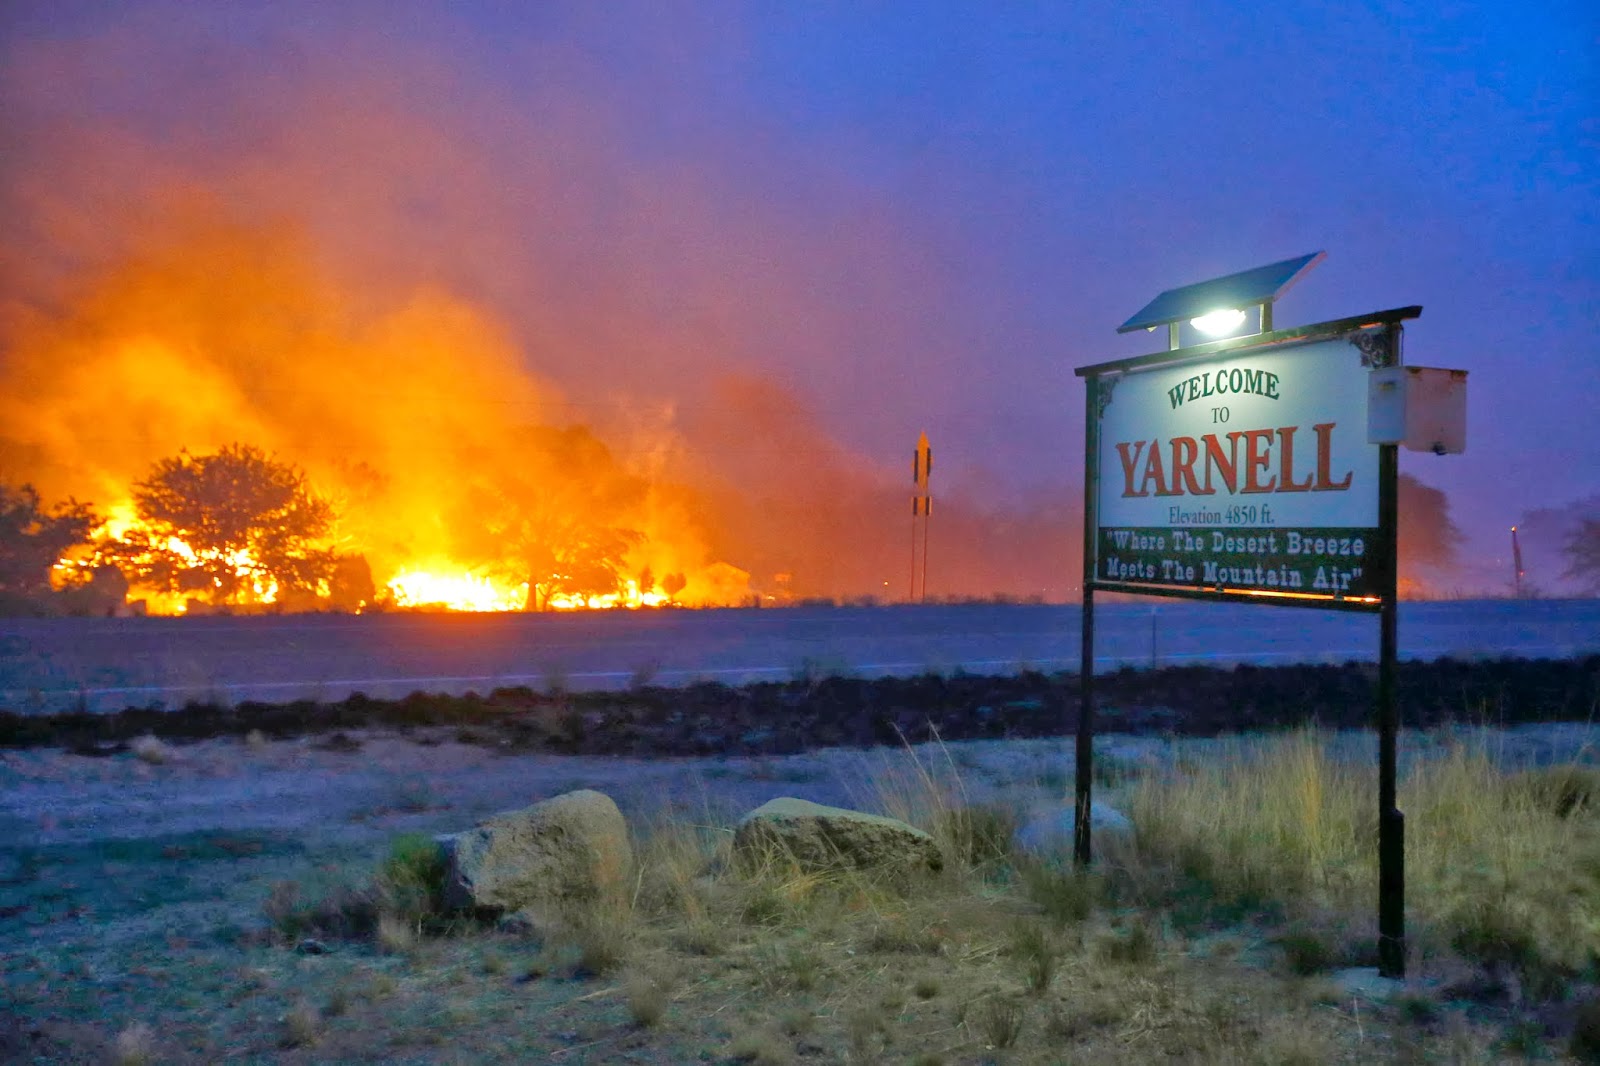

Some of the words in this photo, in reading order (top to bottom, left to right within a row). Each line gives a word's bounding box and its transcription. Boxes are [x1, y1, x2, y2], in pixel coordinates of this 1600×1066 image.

[1167, 368, 1280, 409] WELCOME
[1211, 406, 1230, 424] TO
[1115, 423, 1353, 498] YARNELL
[1168, 505, 1222, 525] Elevation
[1225, 504, 1258, 525] 4850
[1260, 503, 1275, 525] ft.
[1172, 532, 1203, 552] The
[1212, 532, 1278, 554] Desert
[1287, 532, 1365, 556] Breeze
[1107, 557, 1155, 578] Meets
[1162, 560, 1194, 581] The
[1203, 564, 1302, 588] Mountain
